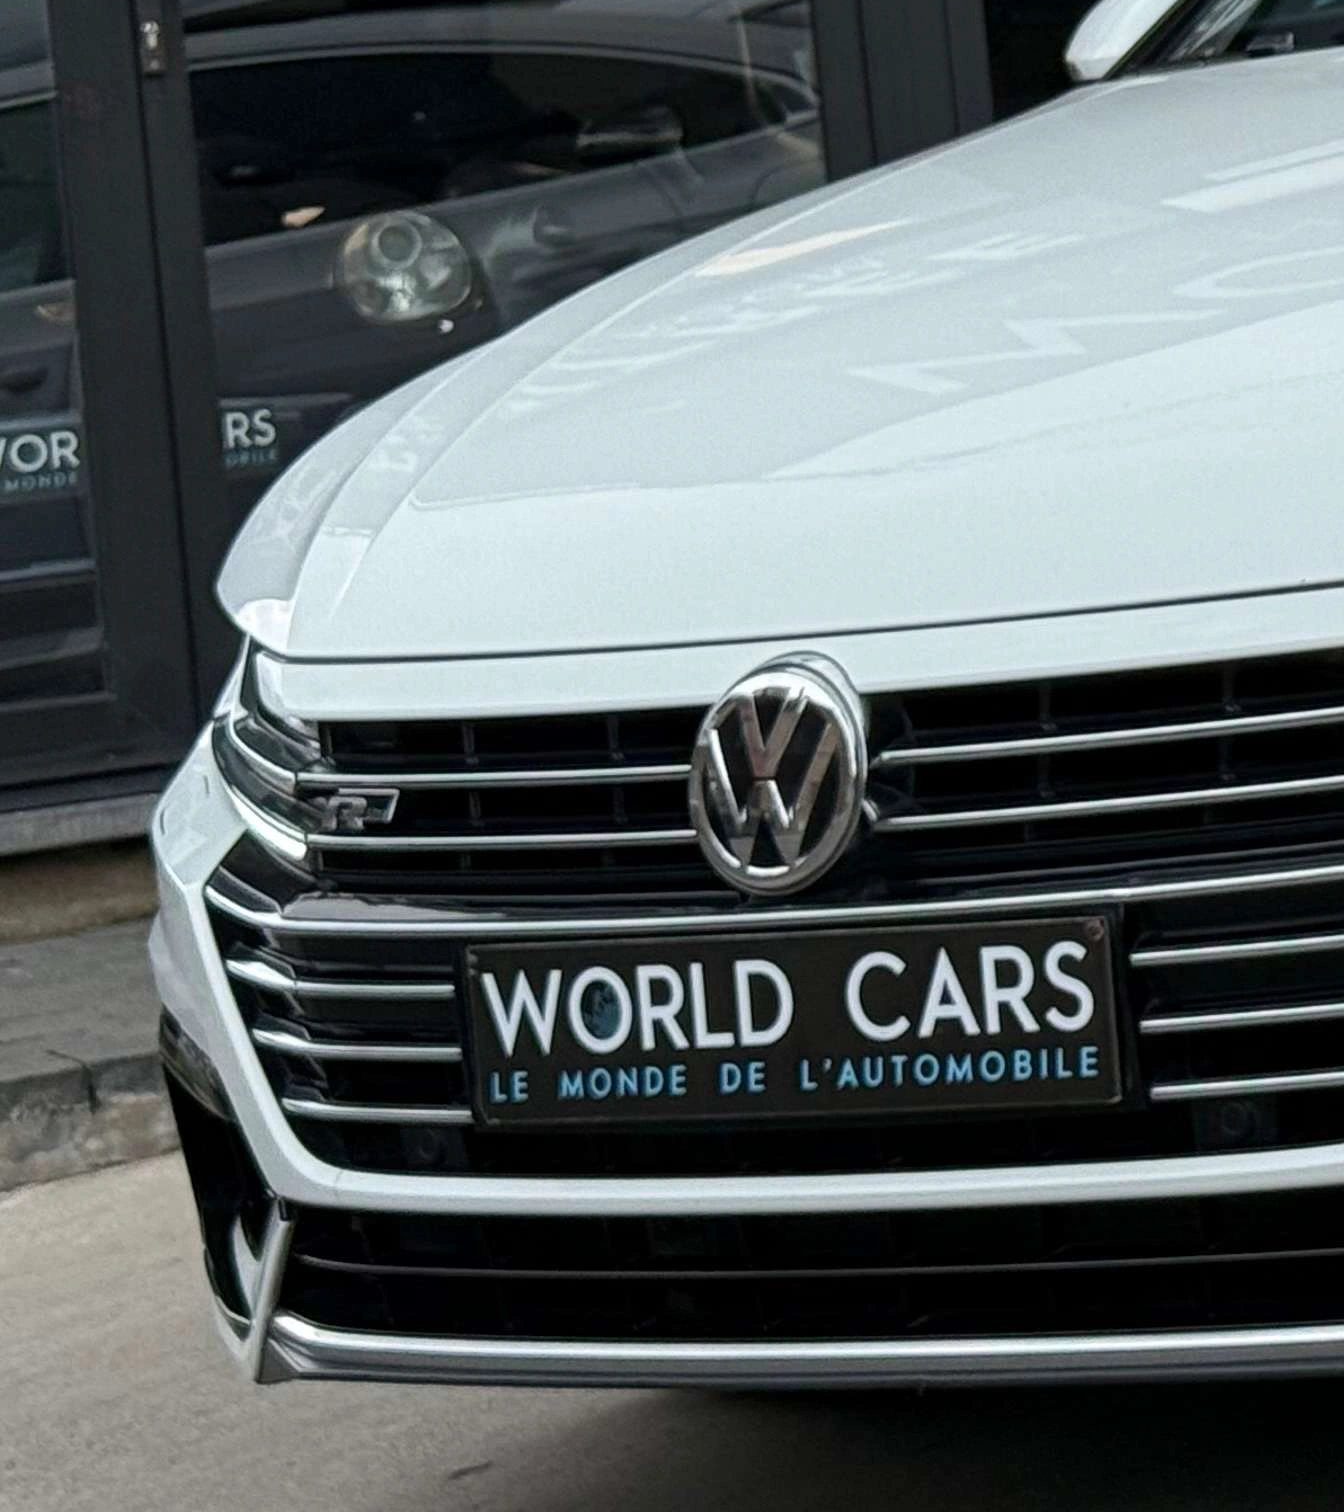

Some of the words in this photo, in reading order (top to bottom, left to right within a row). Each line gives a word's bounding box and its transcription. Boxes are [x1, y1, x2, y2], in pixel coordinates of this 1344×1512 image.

[481, 958, 794, 1058] WORLD
[845, 940, 1096, 1043] CARS
[490, 1070, 529, 1104] LE
[559, 1064, 687, 1100] MONDE
[720, 1060, 767, 1093] DE
[799, 1044, 1100, 1091] L'AUTOMOBILE
